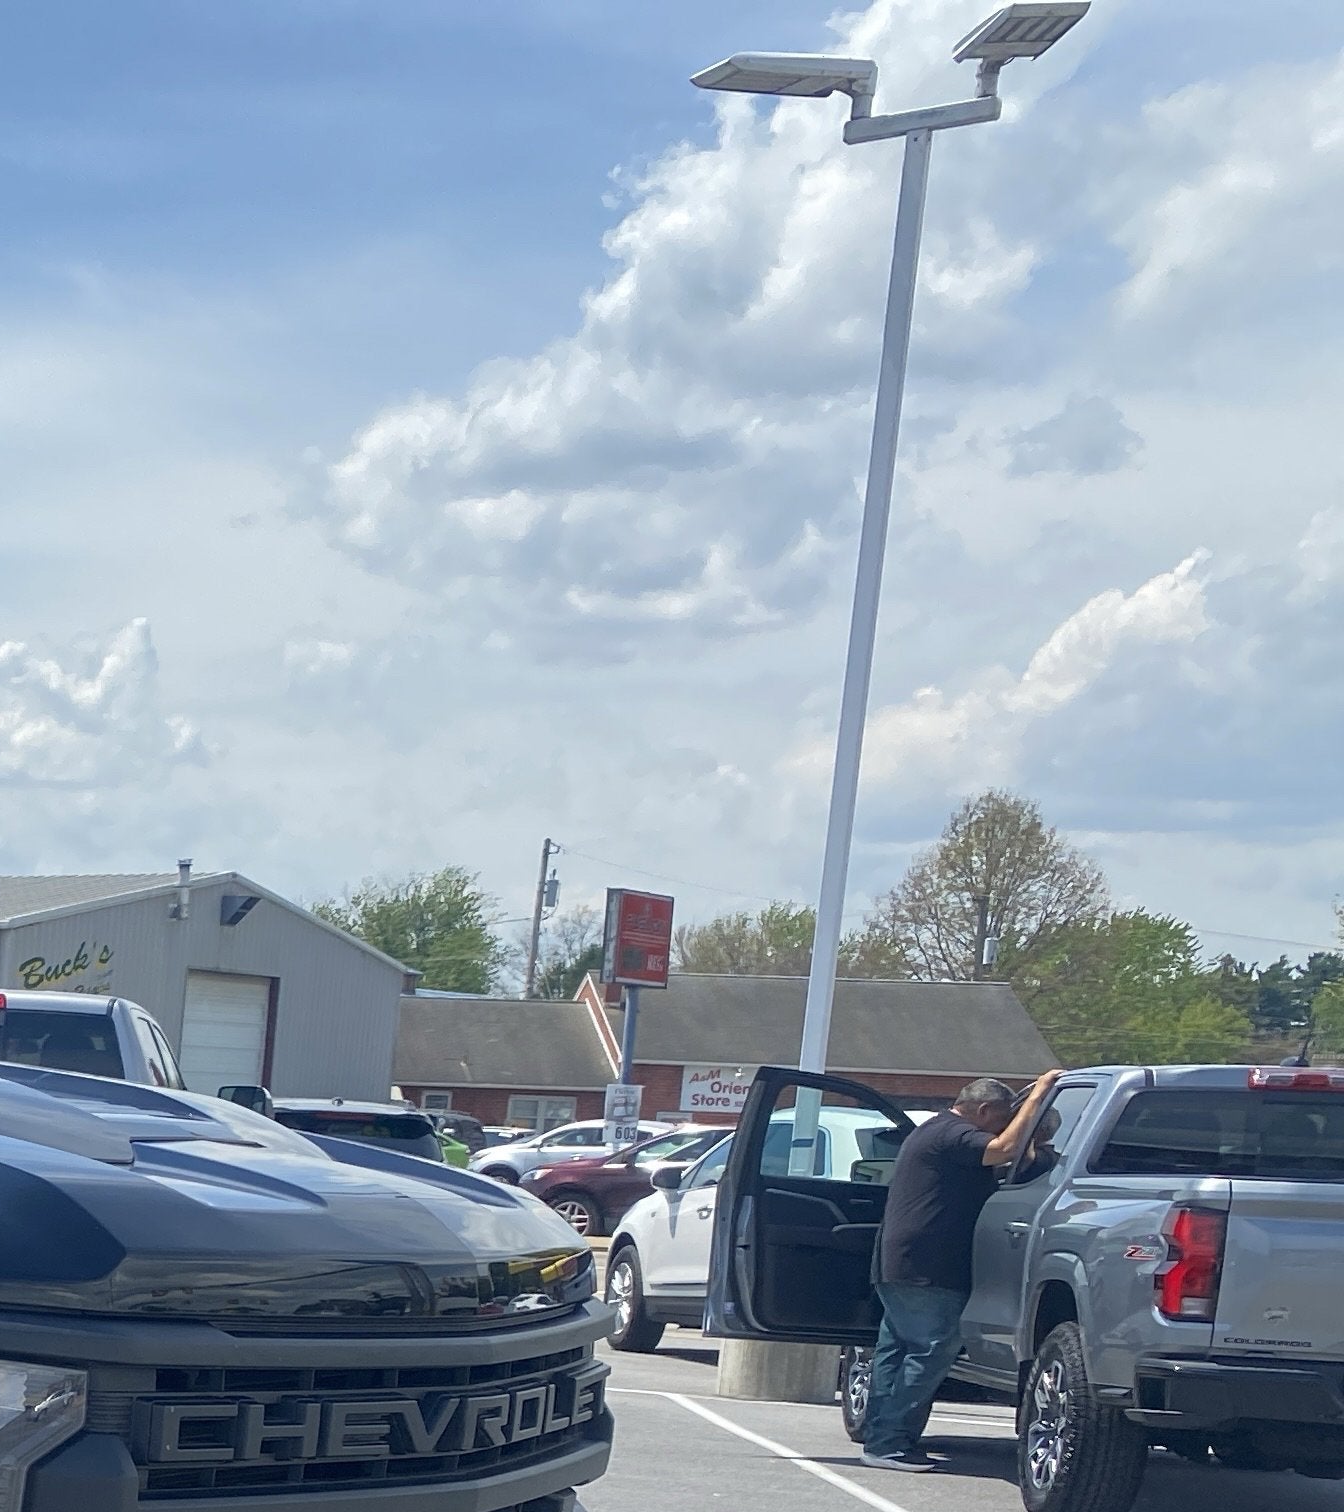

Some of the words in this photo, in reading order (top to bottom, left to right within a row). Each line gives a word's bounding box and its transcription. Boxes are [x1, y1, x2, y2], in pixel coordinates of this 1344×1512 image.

[19, 941, 114, 990] Buck's
[711, 1081, 750, 1095] Orien
[691, 1094, 730, 1107] Store
[1223, 1336, 1313, 1348] COLORADO
